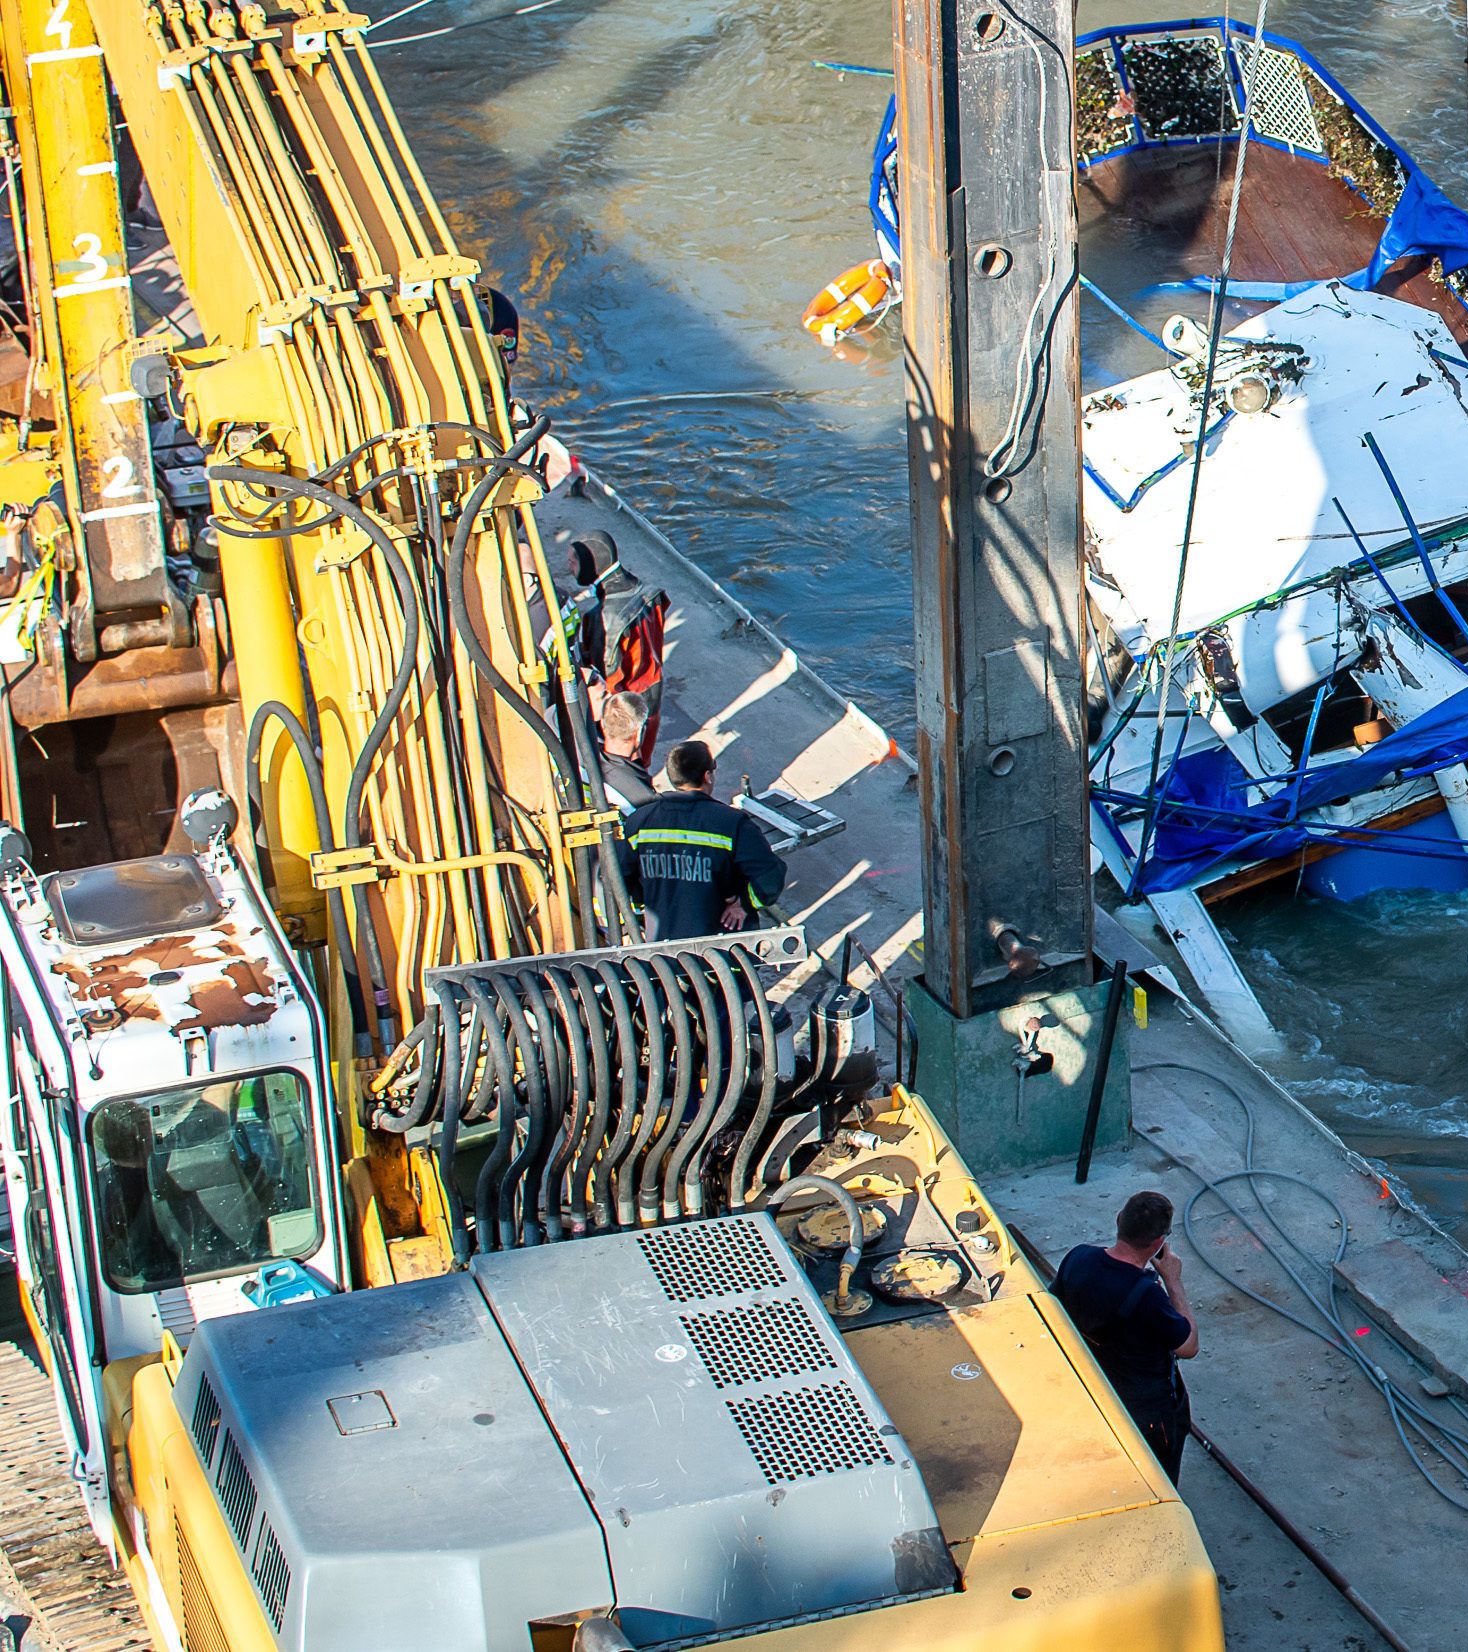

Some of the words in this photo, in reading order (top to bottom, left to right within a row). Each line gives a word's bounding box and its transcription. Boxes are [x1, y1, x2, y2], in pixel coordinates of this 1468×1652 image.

[45, 0, 73, 49] 4
[73, 233, 108, 283] 3
[102, 456, 143, 498] 2
